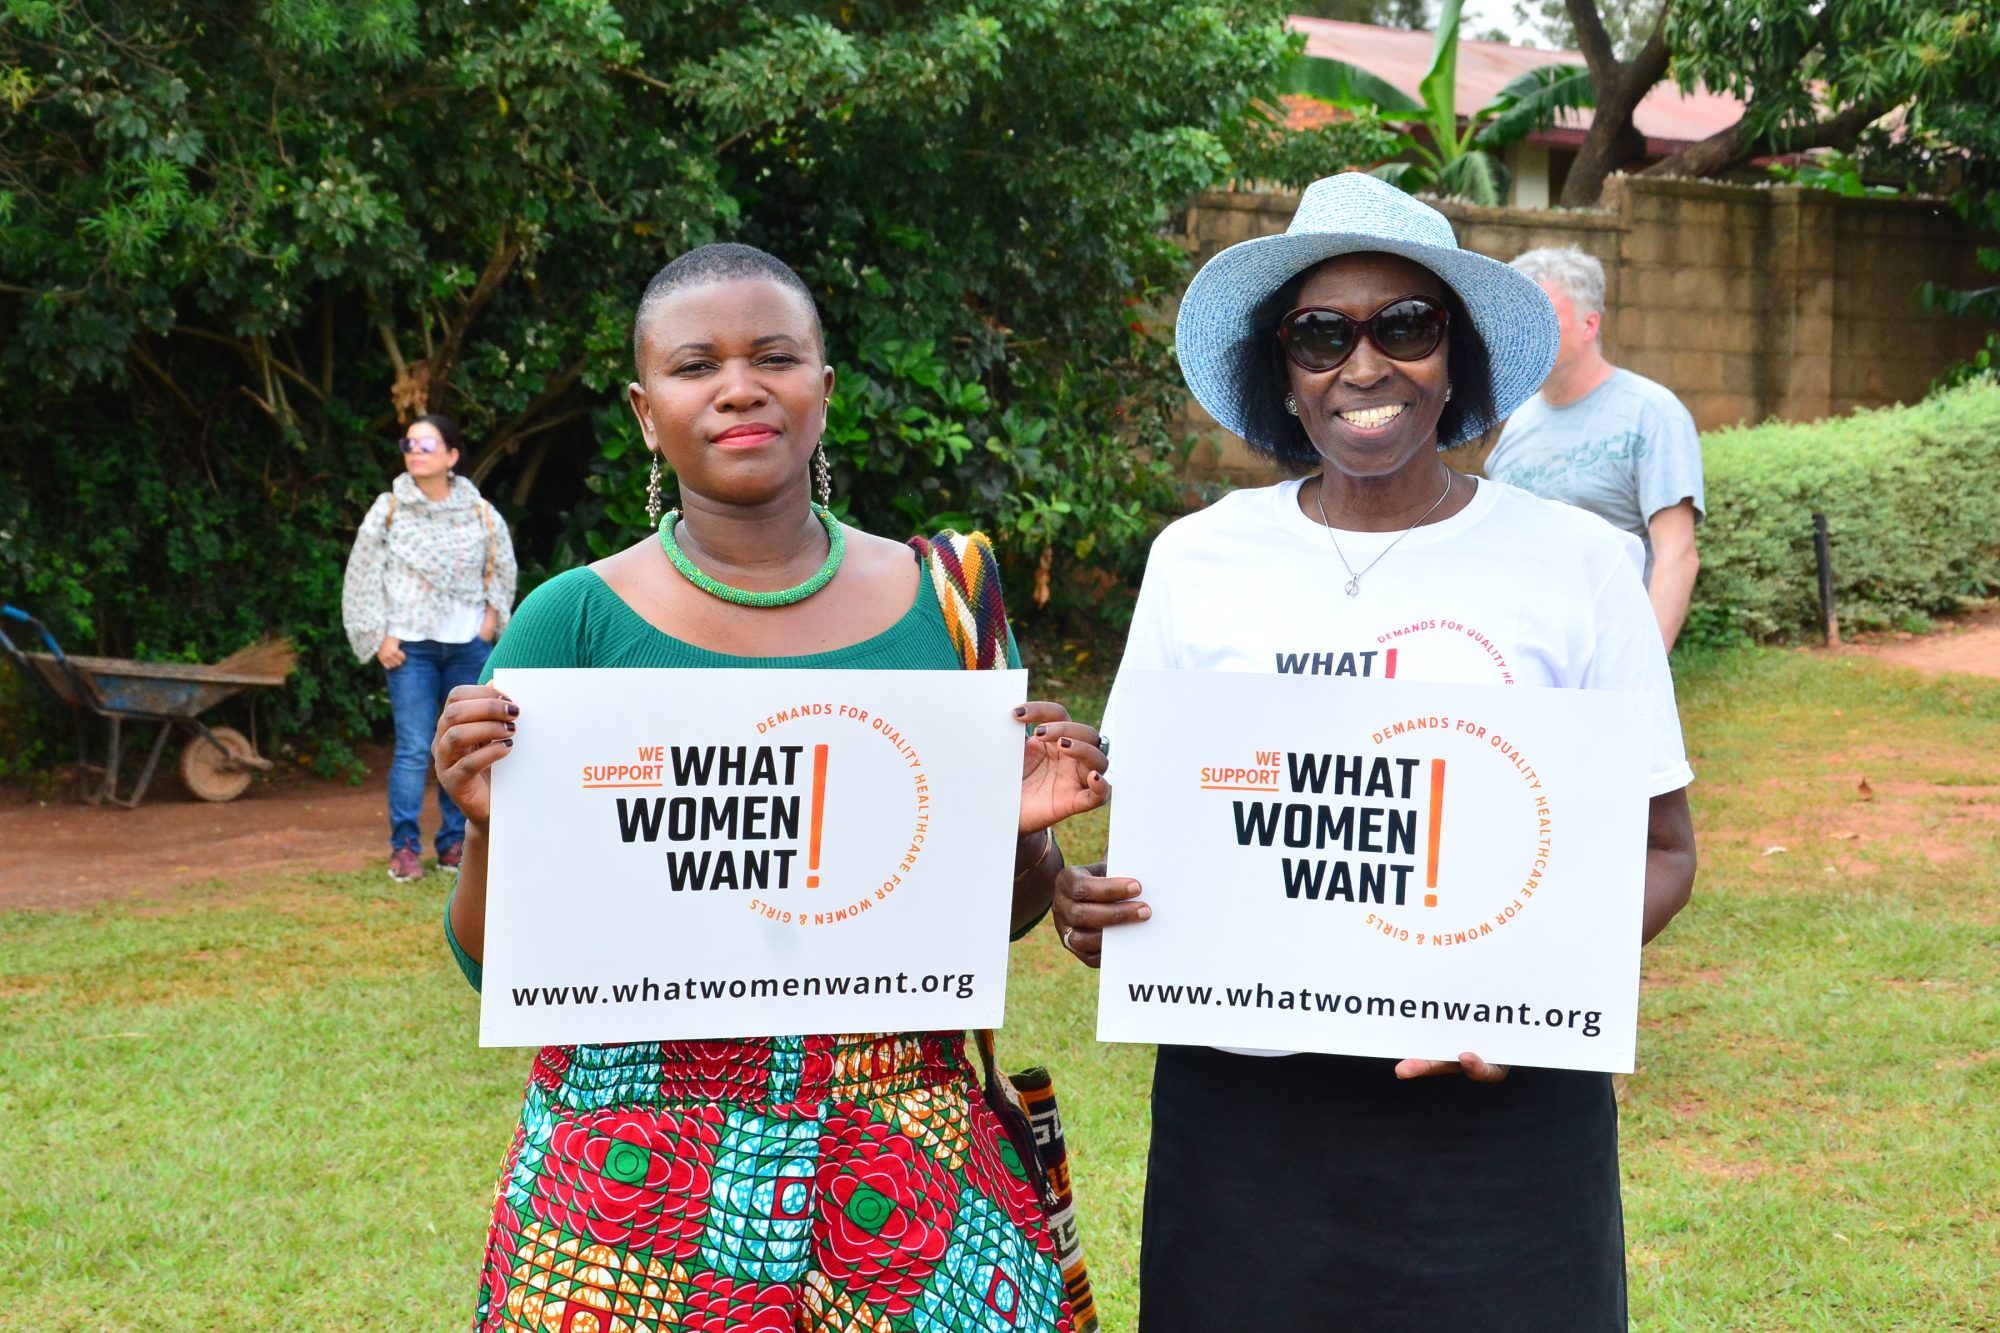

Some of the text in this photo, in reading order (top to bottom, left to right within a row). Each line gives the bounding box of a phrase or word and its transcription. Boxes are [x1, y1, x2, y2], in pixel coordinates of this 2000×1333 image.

[1377, 620, 1436, 644] DEMANDS
[1441, 619, 1463, 633] FOR
[1467, 628, 1507, 667] QUALITY
[1275, 651, 1378, 677] WHAT
[756, 703, 833, 734] DEMANDS
[839, 704, 869, 723] FOR
[872, 717, 921, 769] QUALITY
[1371, 716, 1449, 745] DEMANDS
[1456, 720, 1487, 739] FOR
[638, 747, 664, 762] WE
[670, 746, 803, 786] WHAT
[1256, 751, 1281, 766] WE
[1490, 735, 1542, 789] QUALITY
[583, 765, 664, 782] SUPPORT
[1200, 768, 1280, 785] SUPPORT
[1287, 752, 1420, 799] WHAT
[616, 796, 800, 843] WOMEN
[899, 773, 929, 873] HEALTHCARE
[1232, 801, 1417, 855] WOMEN
[1520, 796, 1551, 899] HEALTHCARE
[666, 849, 797, 891] WANT
[1282, 858, 1414, 906] WANT
[874, 874, 902, 900] FOR
[749, 899, 792, 923] GIRLS
[814, 899, 872, 925] WOMEN
[1495, 899, 1523, 926] FOR
[1365, 913, 1409, 942] GIRLS
[1433, 922, 1493, 946] WOMEN
[511, 971, 975, 1007] www.whatwomenwant.org
[1128, 983, 1603, 1038] www.whatwomenwant.org
